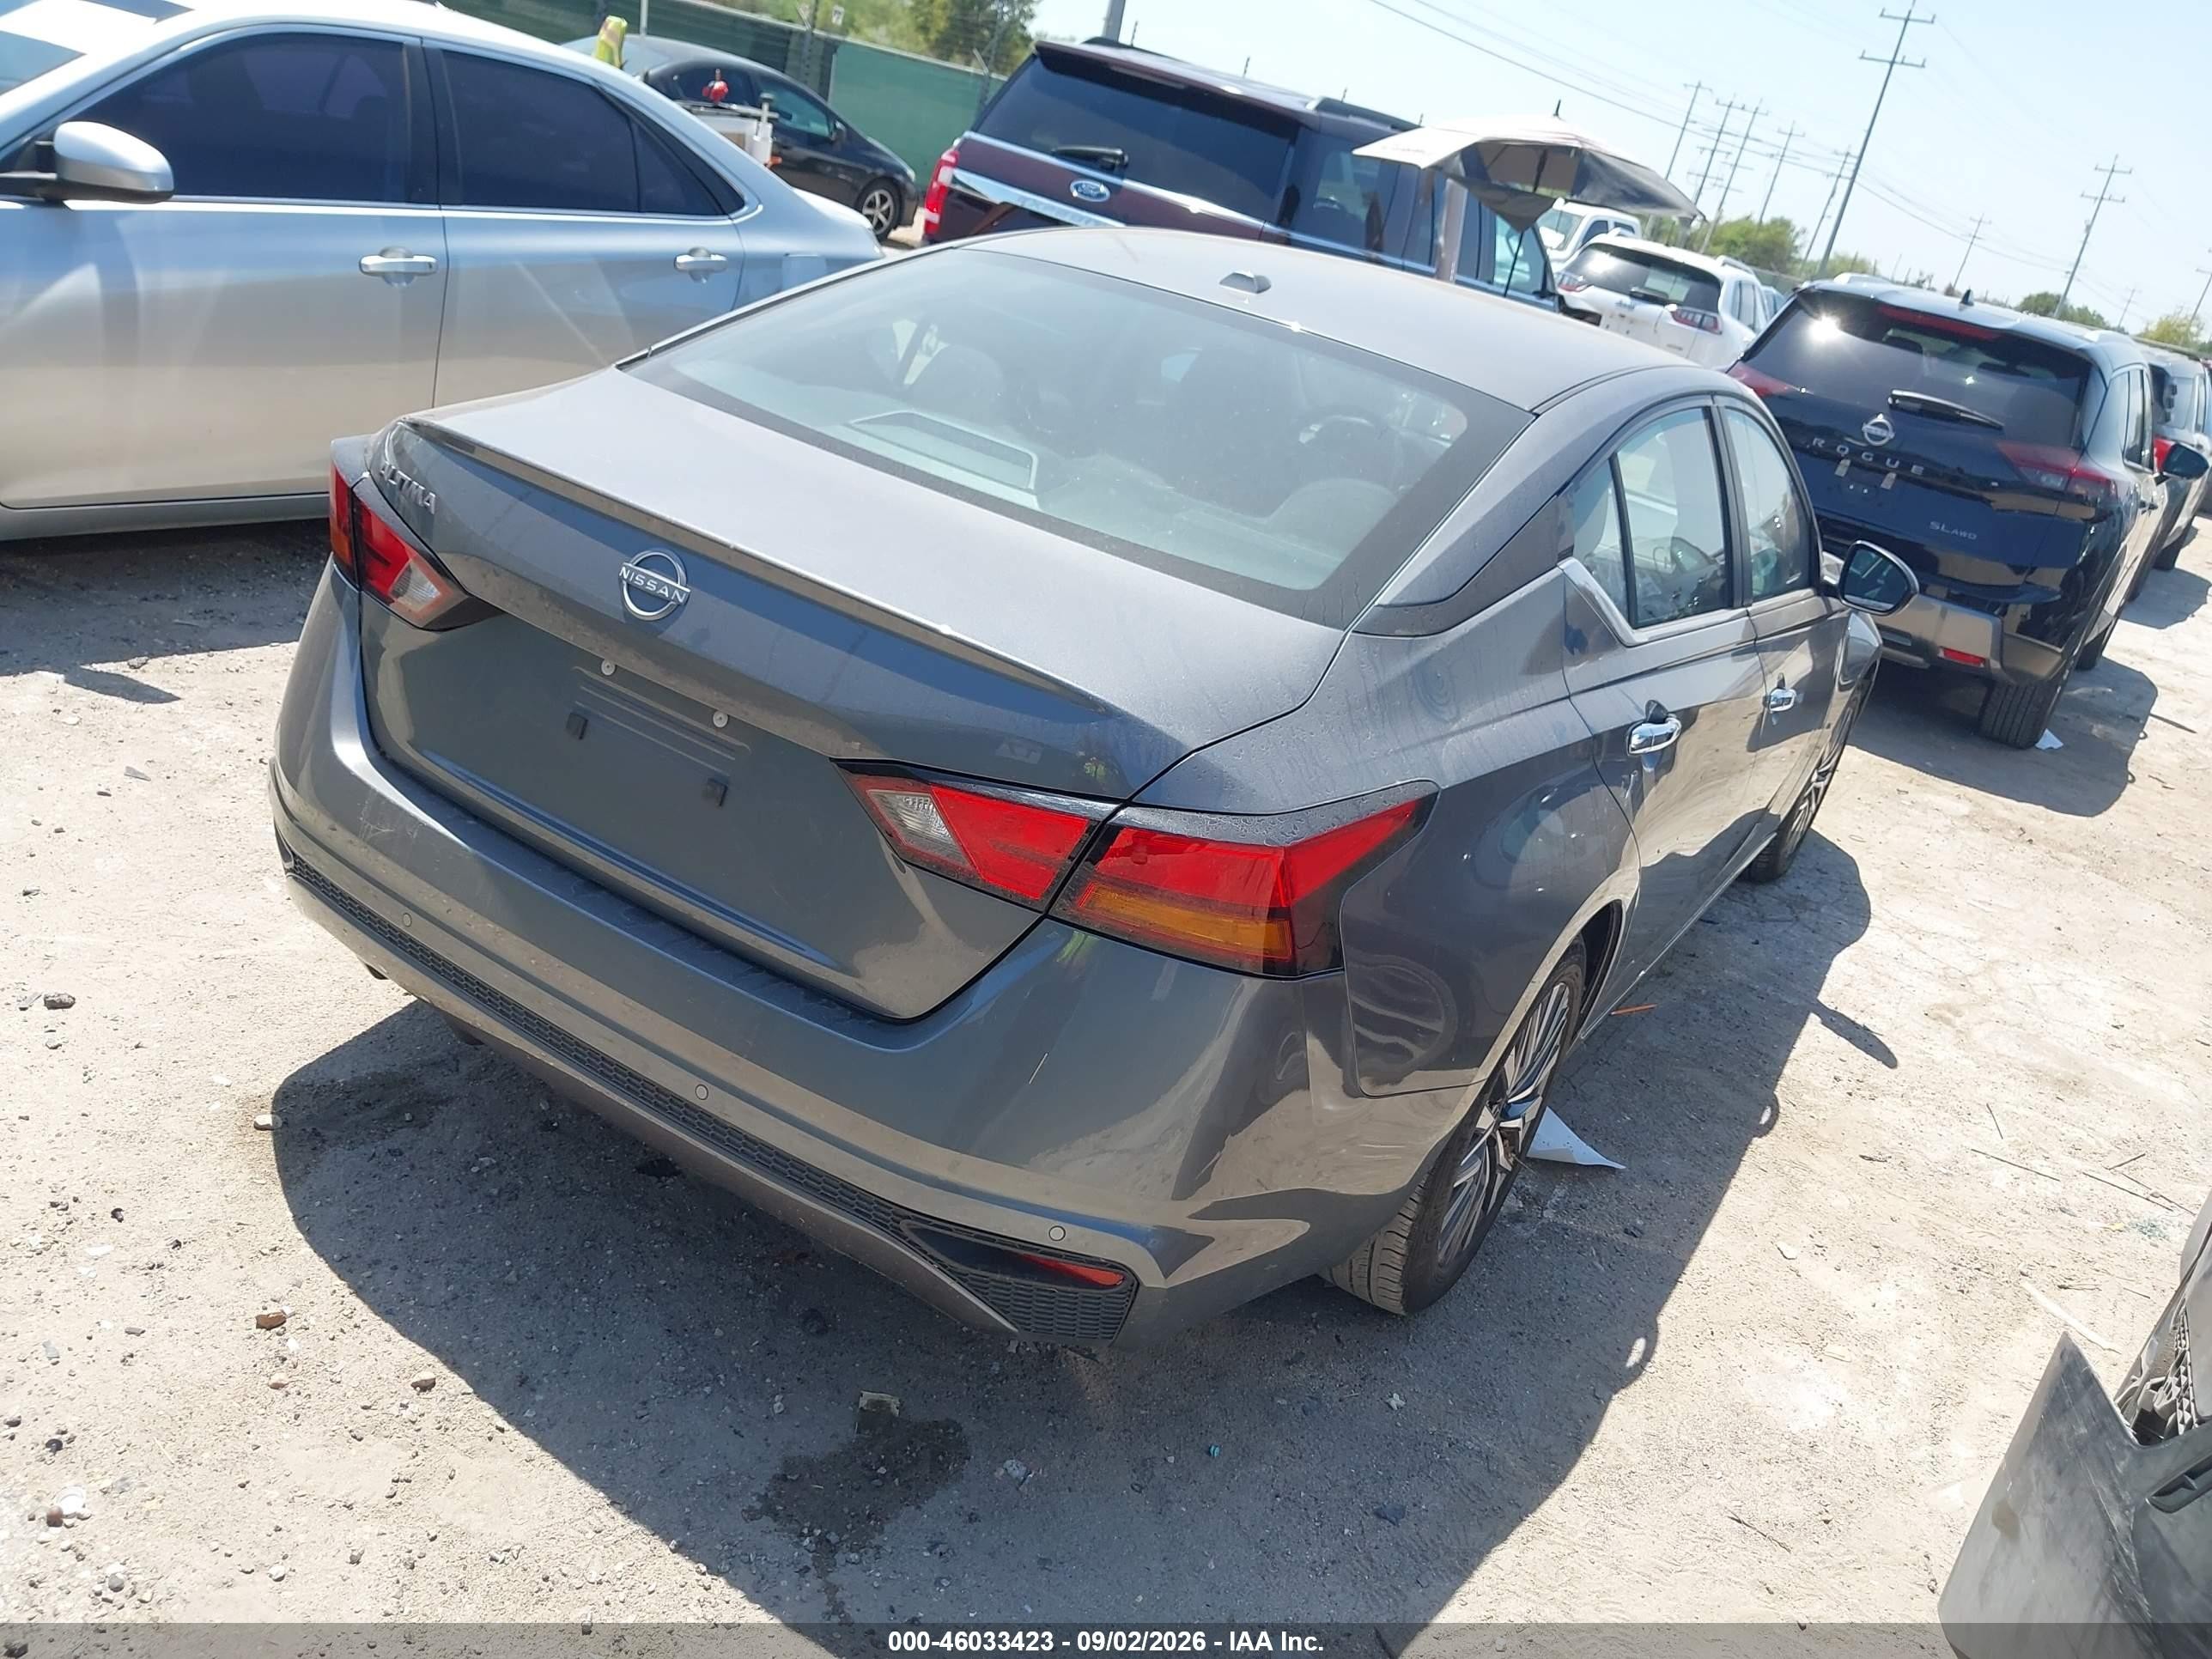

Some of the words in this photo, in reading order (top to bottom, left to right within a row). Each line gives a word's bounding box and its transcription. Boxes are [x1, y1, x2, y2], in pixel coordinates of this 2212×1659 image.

[1812, 437, 1924, 476] ROGUE
[379, 465, 437, 515] ALTIMA
[618, 565, 687, 604] NISSAN
